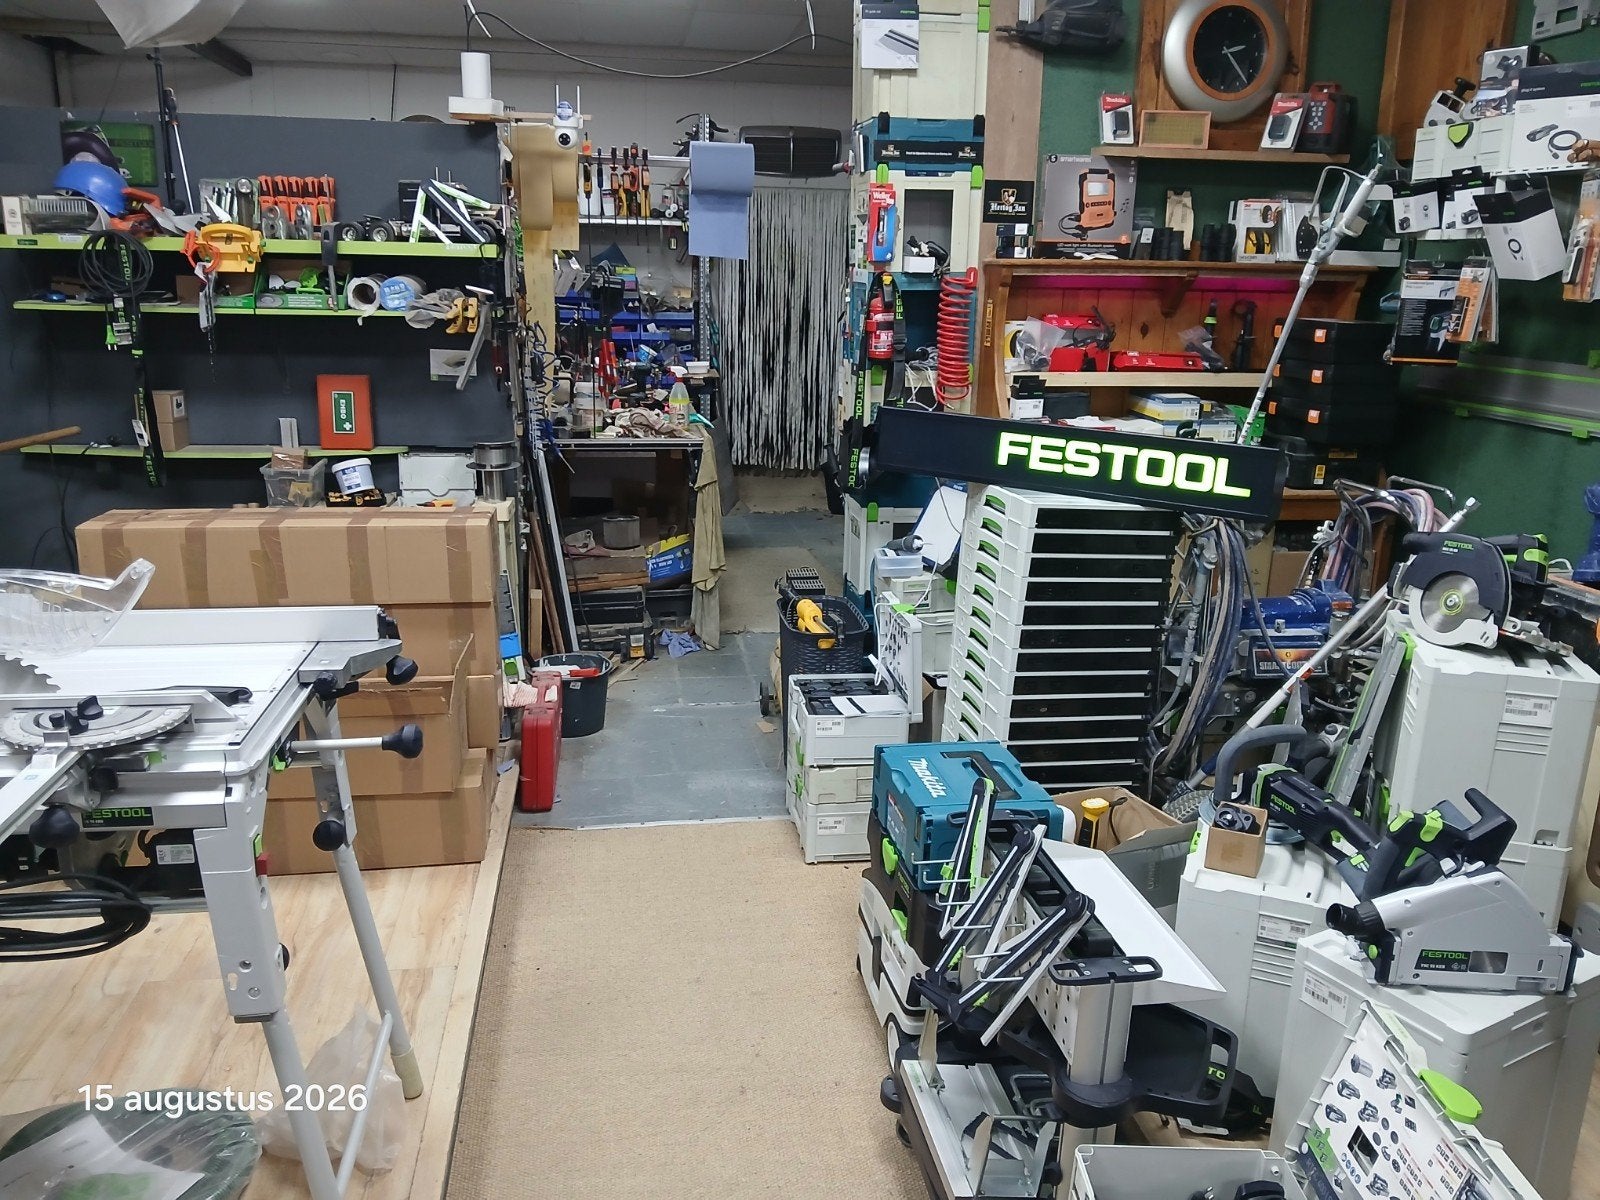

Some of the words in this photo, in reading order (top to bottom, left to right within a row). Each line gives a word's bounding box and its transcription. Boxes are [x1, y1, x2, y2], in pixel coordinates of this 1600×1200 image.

[339, 399, 347, 420] EHBO
[855, 370, 865, 420] FESTOOL
[997, 431, 1251, 498] FESTOOL
[907, 758, 947, 798] Makita
[1422, 951, 1469, 960] FESTOOL
